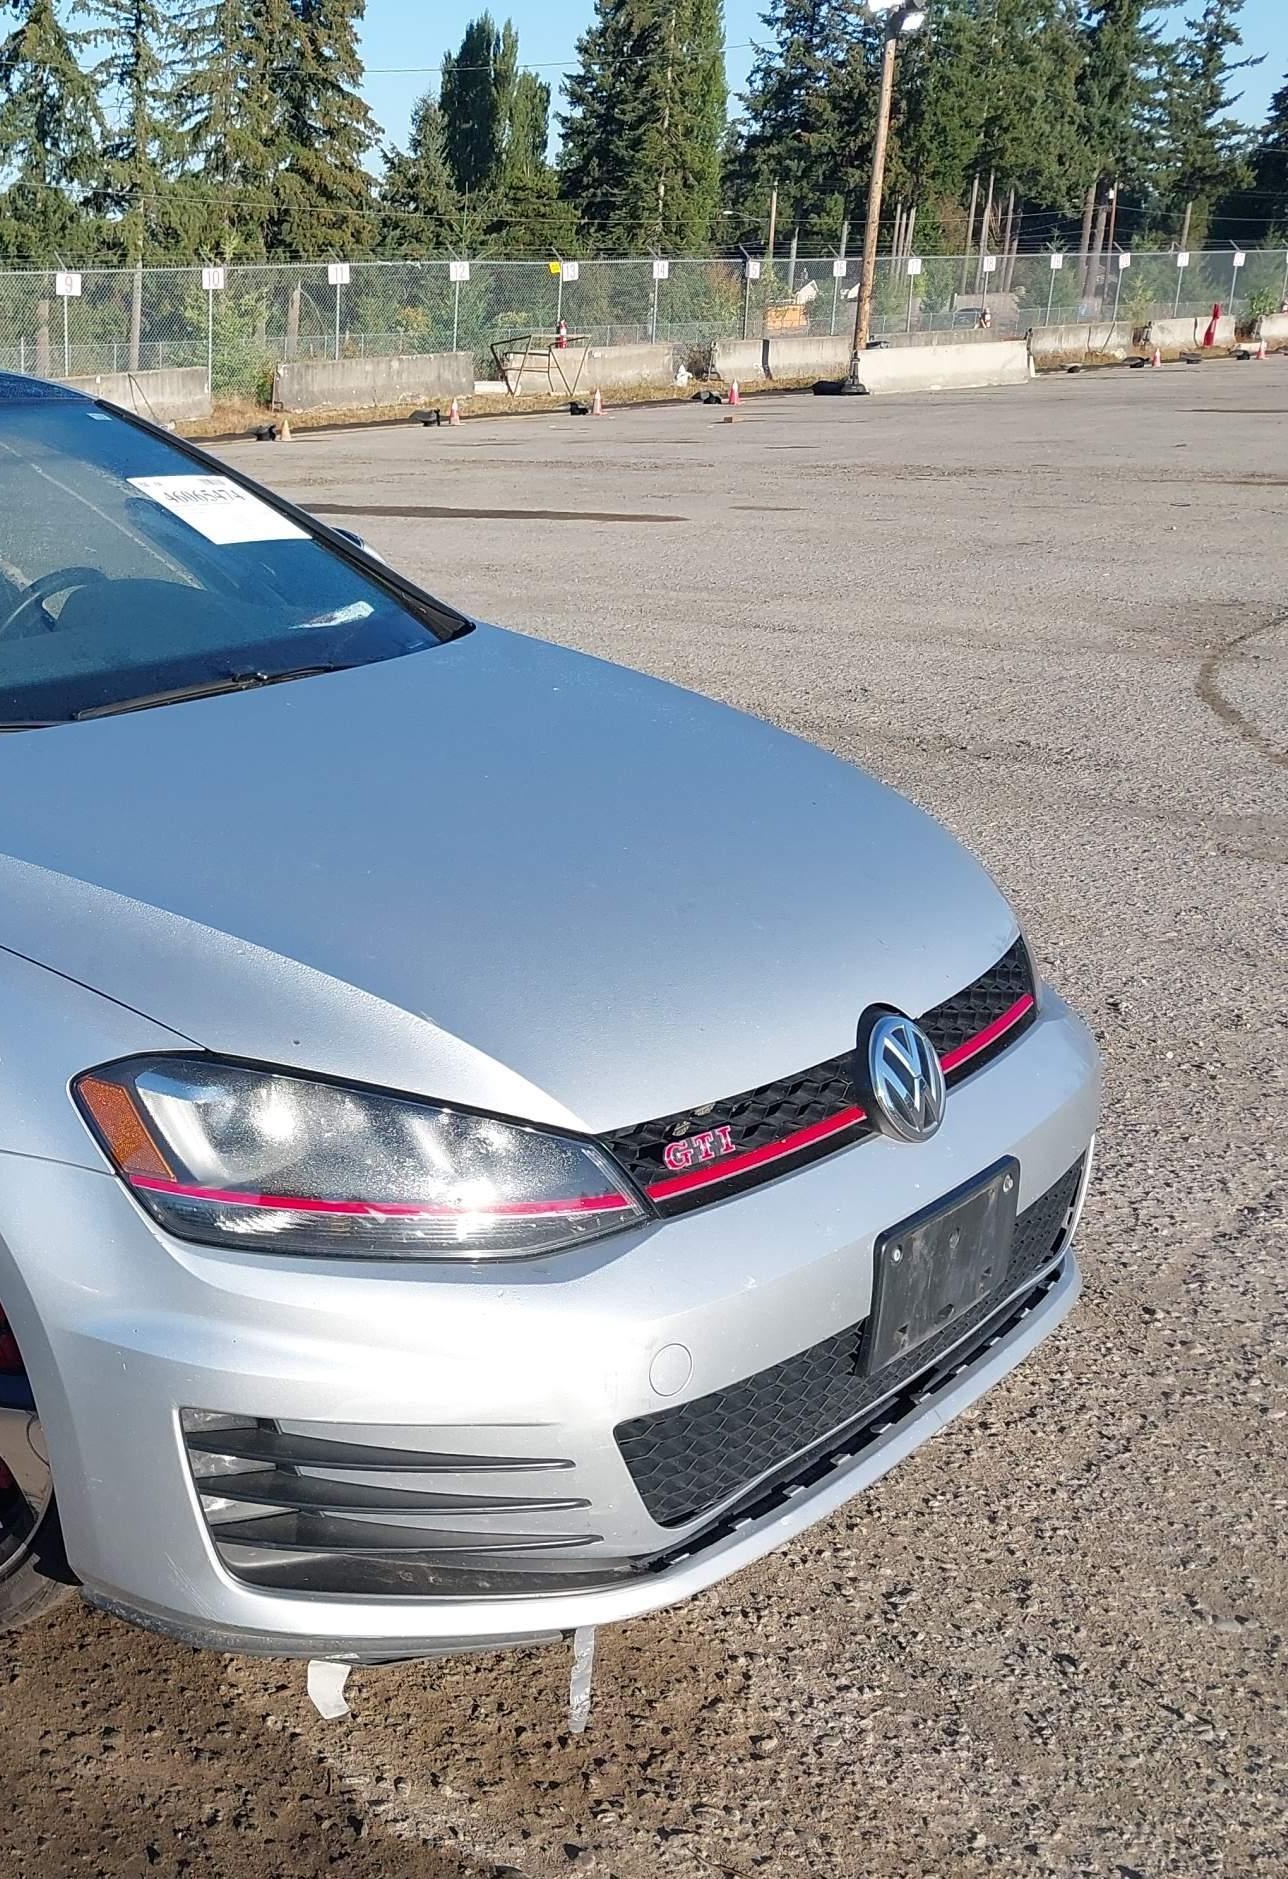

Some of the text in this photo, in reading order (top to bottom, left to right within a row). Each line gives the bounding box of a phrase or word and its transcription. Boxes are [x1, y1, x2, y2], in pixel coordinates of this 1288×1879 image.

[207, 270, 220, 288] 10
[454, 263, 466, 279] 12
[566, 263, 576, 279] 13
[64, 275, 73, 294] 9
[664, 1125, 735, 1170] GTI
